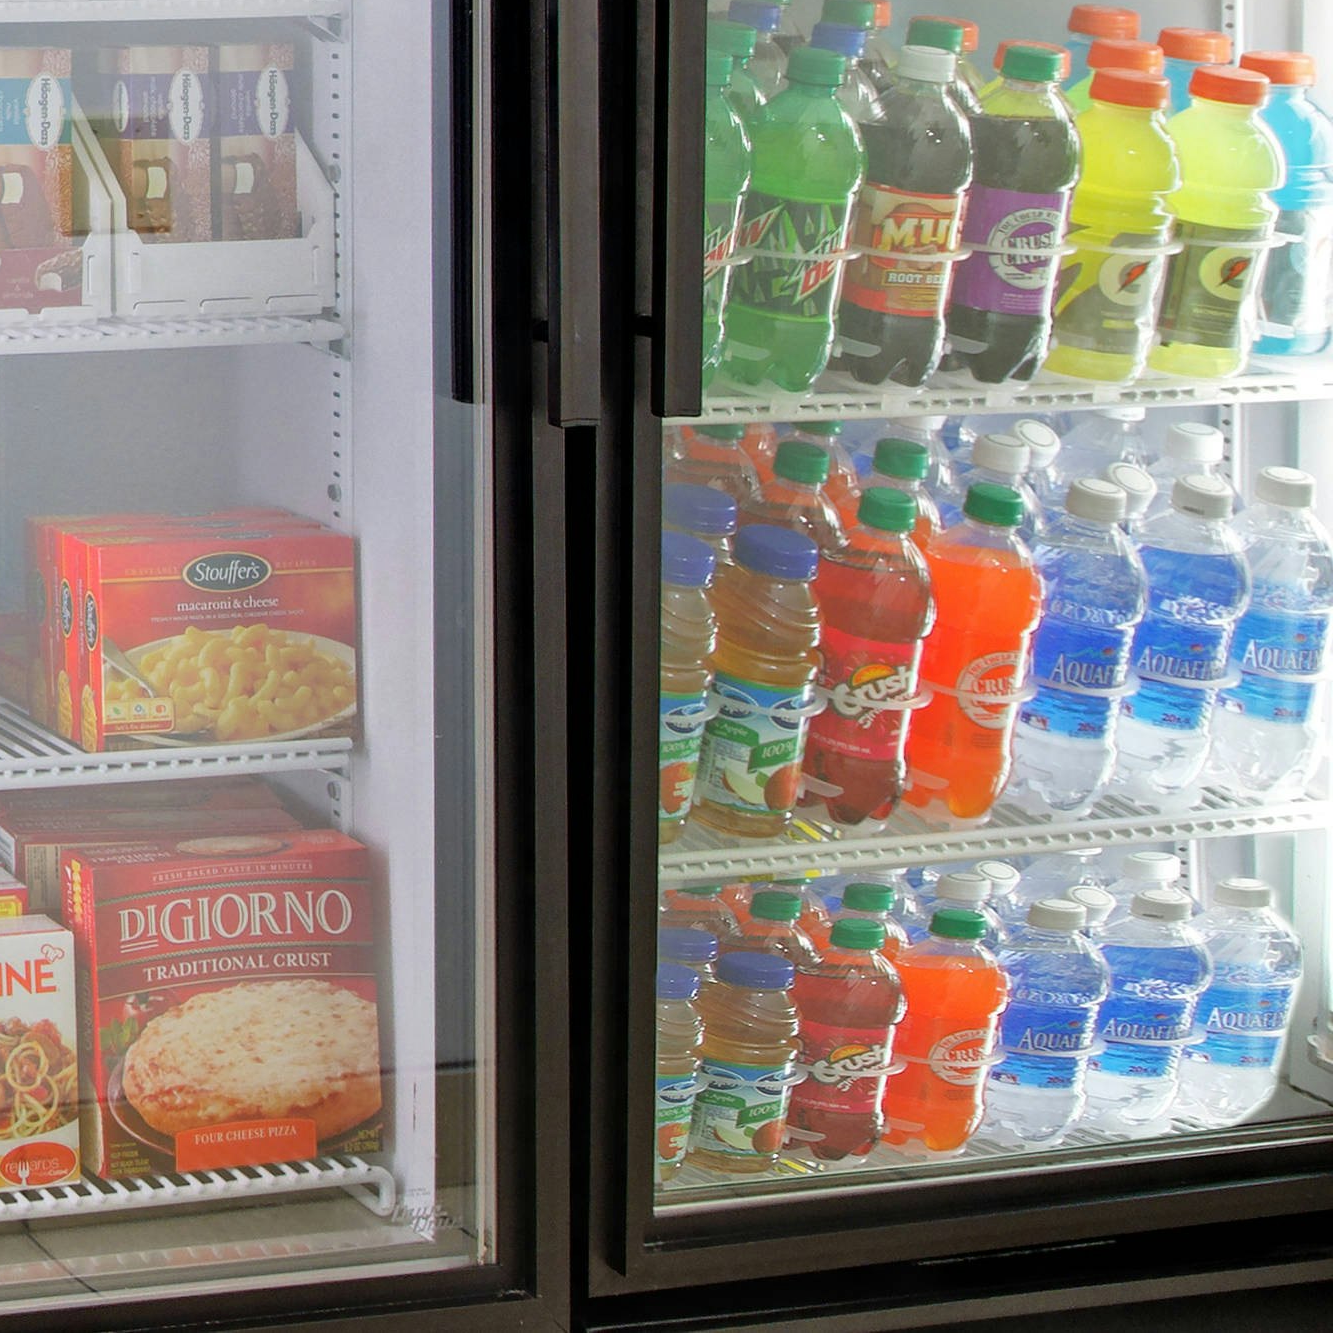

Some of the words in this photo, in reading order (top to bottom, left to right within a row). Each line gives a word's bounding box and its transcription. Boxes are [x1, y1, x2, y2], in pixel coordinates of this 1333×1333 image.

[40, 77, 51, 147] Häagen-Dazs
[182, 73, 192, 141] Häagen-Dazs
[268, 70, 279, 138] Häagen-Dazs
[888, 272, 922, 284] ROOT
[194, 561, 261, 585] Stouffer's
[177, 597, 232, 612] macaroni
[244, 596, 279, 609] cheese
[119, 889, 353, 944] DIGIORNO
[143, 954, 269, 982] TRADITIONAL
[273, 952, 332, 967] CRUST
[194, 1133, 224, 1144] FOUR
[226, 1128, 264, 1141] CHEESE
[267, 1126, 297, 1137] PIZZA
